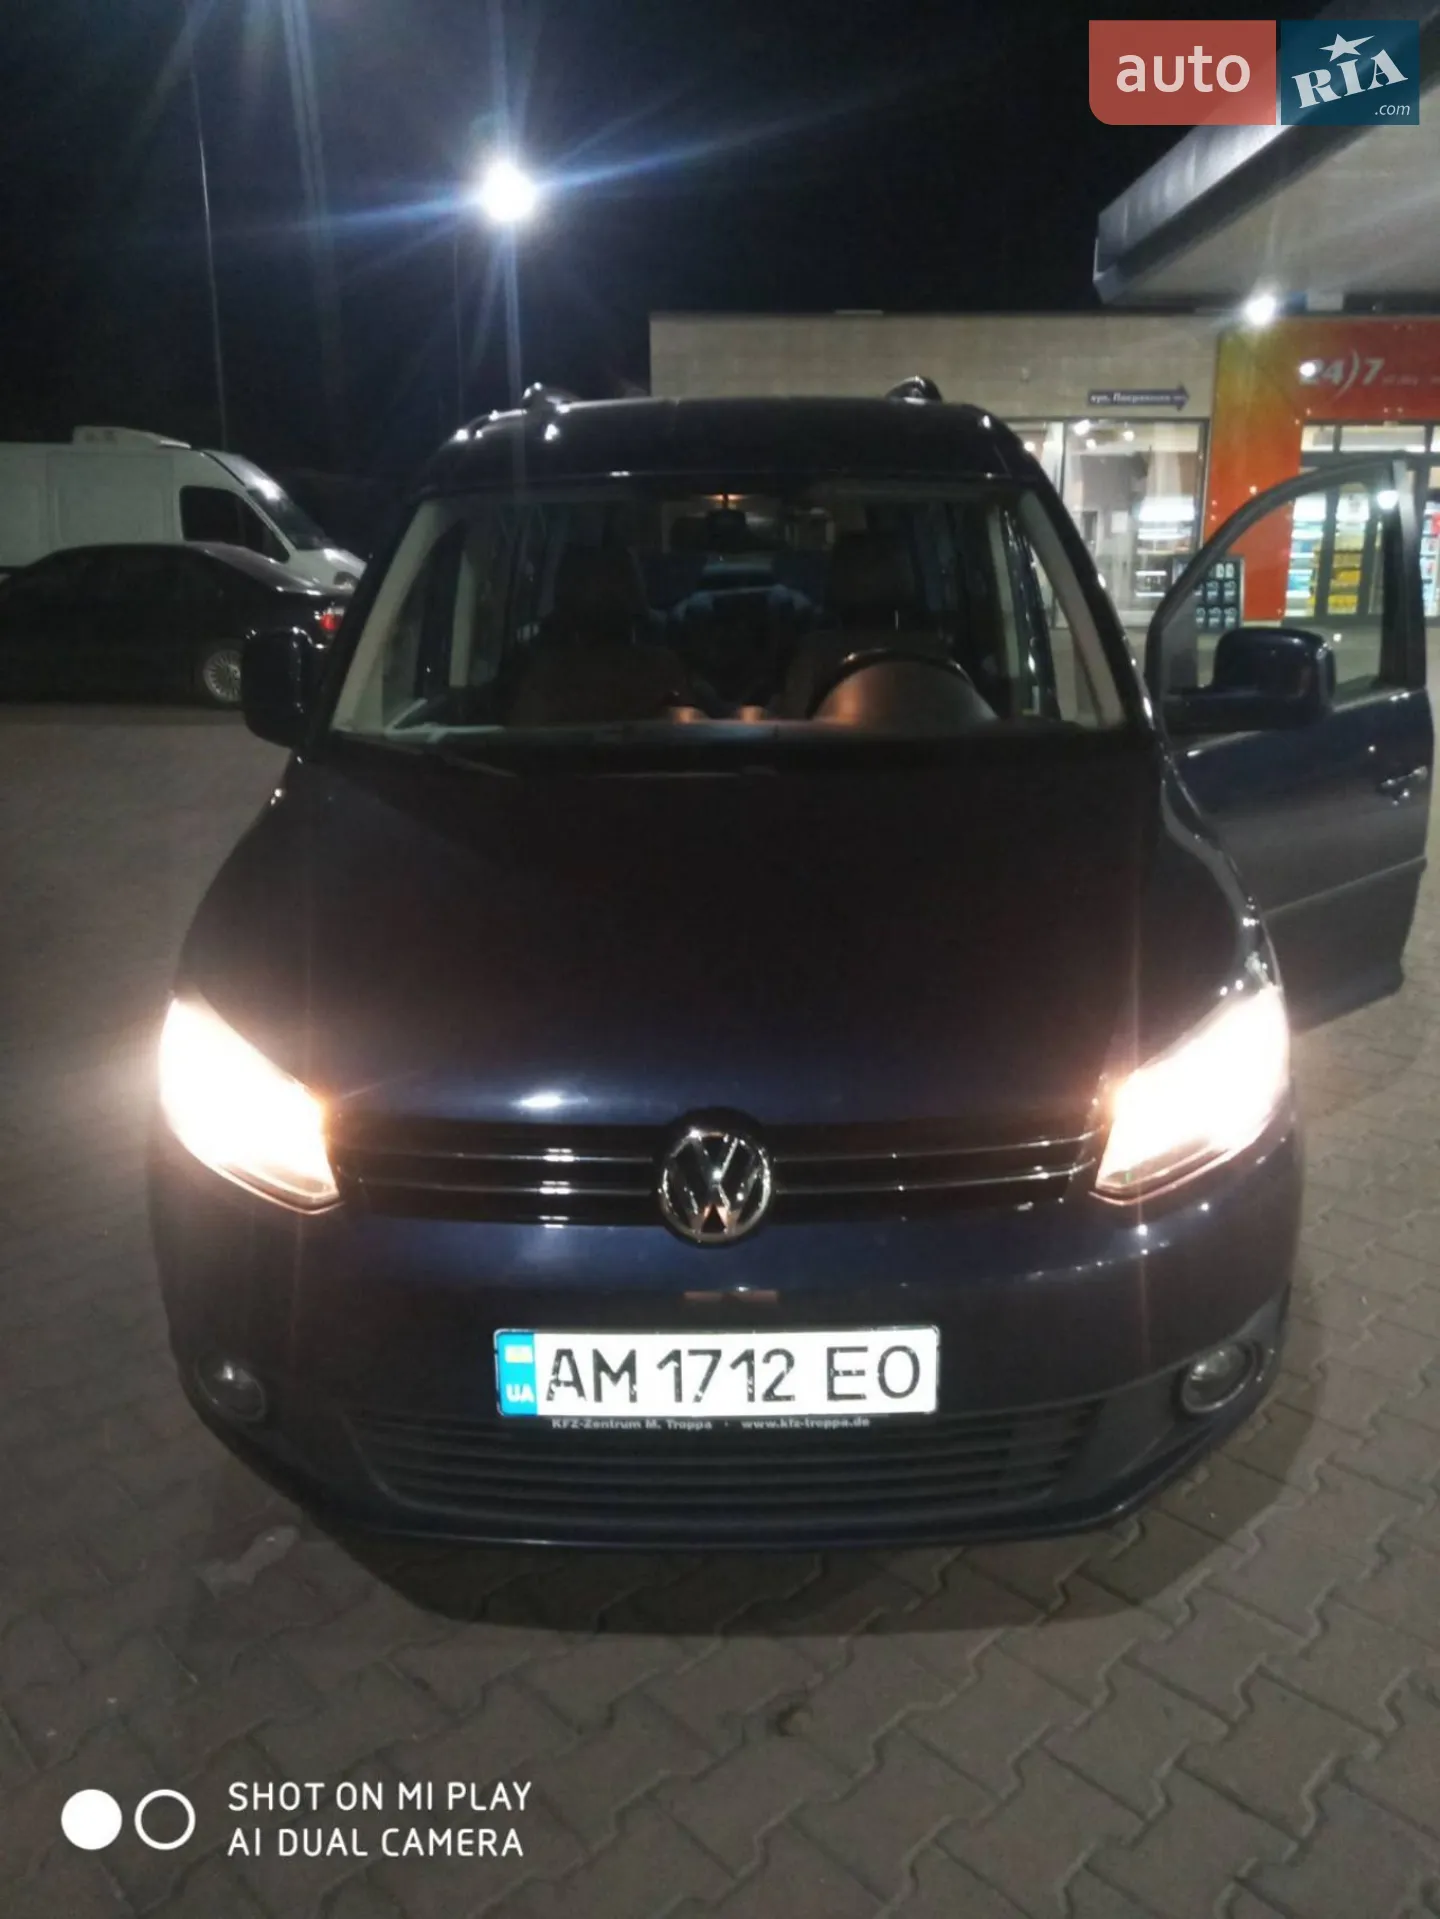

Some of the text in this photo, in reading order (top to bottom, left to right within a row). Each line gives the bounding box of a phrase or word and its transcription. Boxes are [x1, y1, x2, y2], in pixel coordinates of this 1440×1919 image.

[545, 1345, 921, 1403] AM 1712 EO
[505, 1383, 536, 1403] UA
[551, 1417, 642, 1430] KFZ-Zentrum
[645, 1418, 662, 1430] M.
